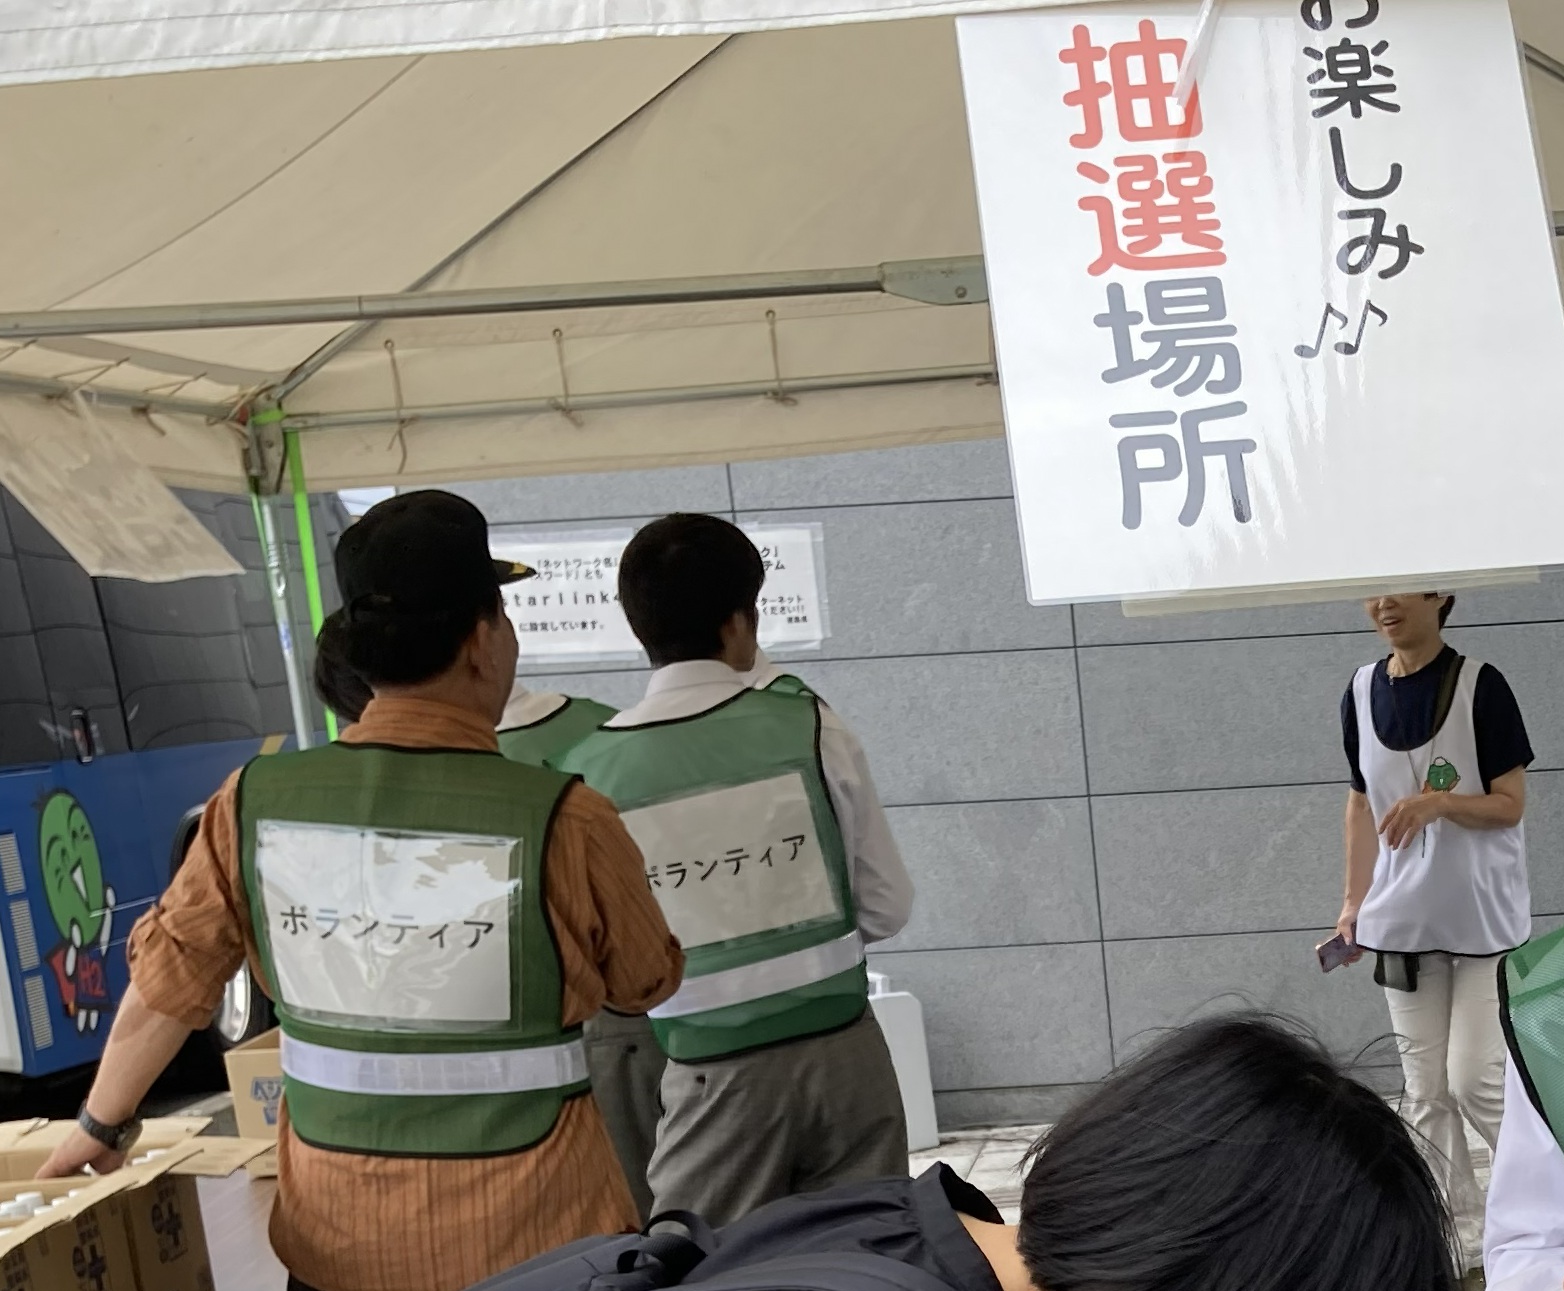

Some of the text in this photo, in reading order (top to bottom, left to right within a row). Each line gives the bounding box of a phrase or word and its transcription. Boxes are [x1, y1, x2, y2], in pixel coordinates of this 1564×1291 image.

[1058, 19, 1257, 531] 抽選場所
[280, 905, 495, 949] ボランティア
